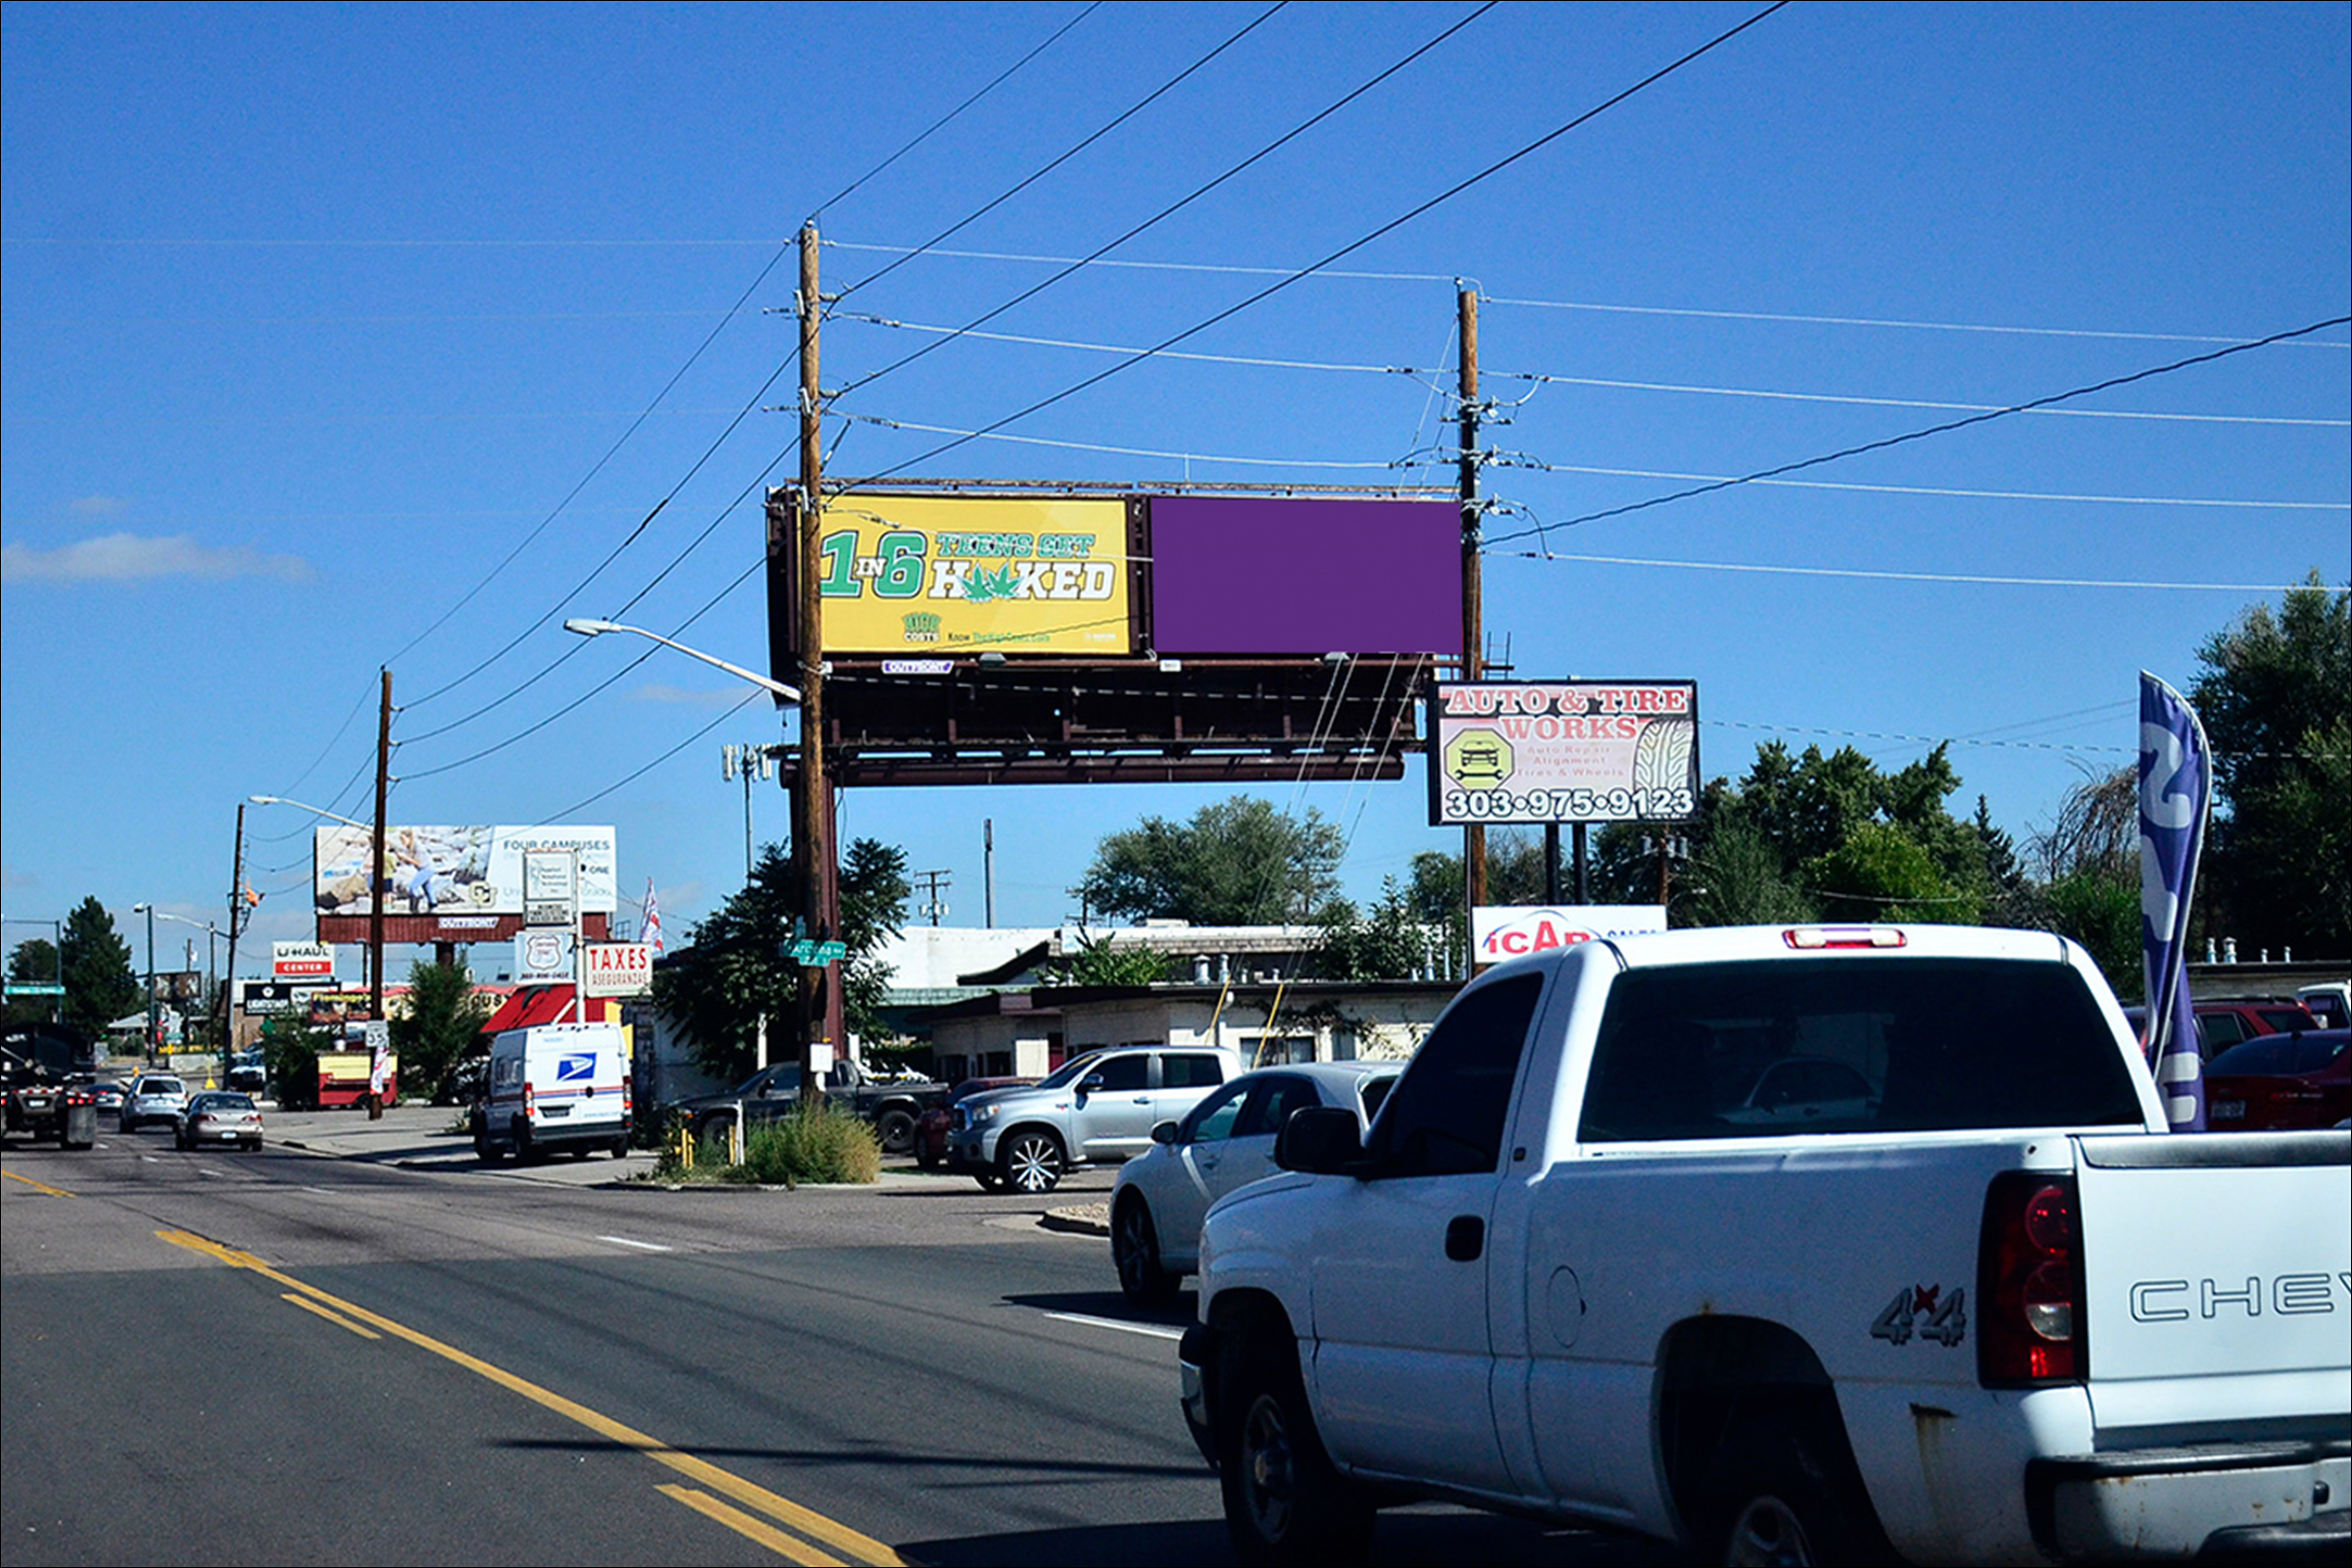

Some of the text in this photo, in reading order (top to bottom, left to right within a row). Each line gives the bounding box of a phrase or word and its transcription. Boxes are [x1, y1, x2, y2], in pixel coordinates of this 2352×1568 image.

[936, 532, 1096, 559] TEENS GET
[821, 530, 927, 598] 1 IN 6
[927, 561, 1115, 602] HKED
[1447, 689, 1687, 712] AUTO & TIRE
[1499, 717, 1637, 740] WORKS
[1533, 757, 1606, 765] Alignment
[1564, 746, 1611, 755] Repair
[1573, 768, 1625, 777] Wheels
[282, 962, 323, 971] CENTER
[589, 948, 647, 971] TAXES
[2130, 1271, 2351, 1323] CHE
